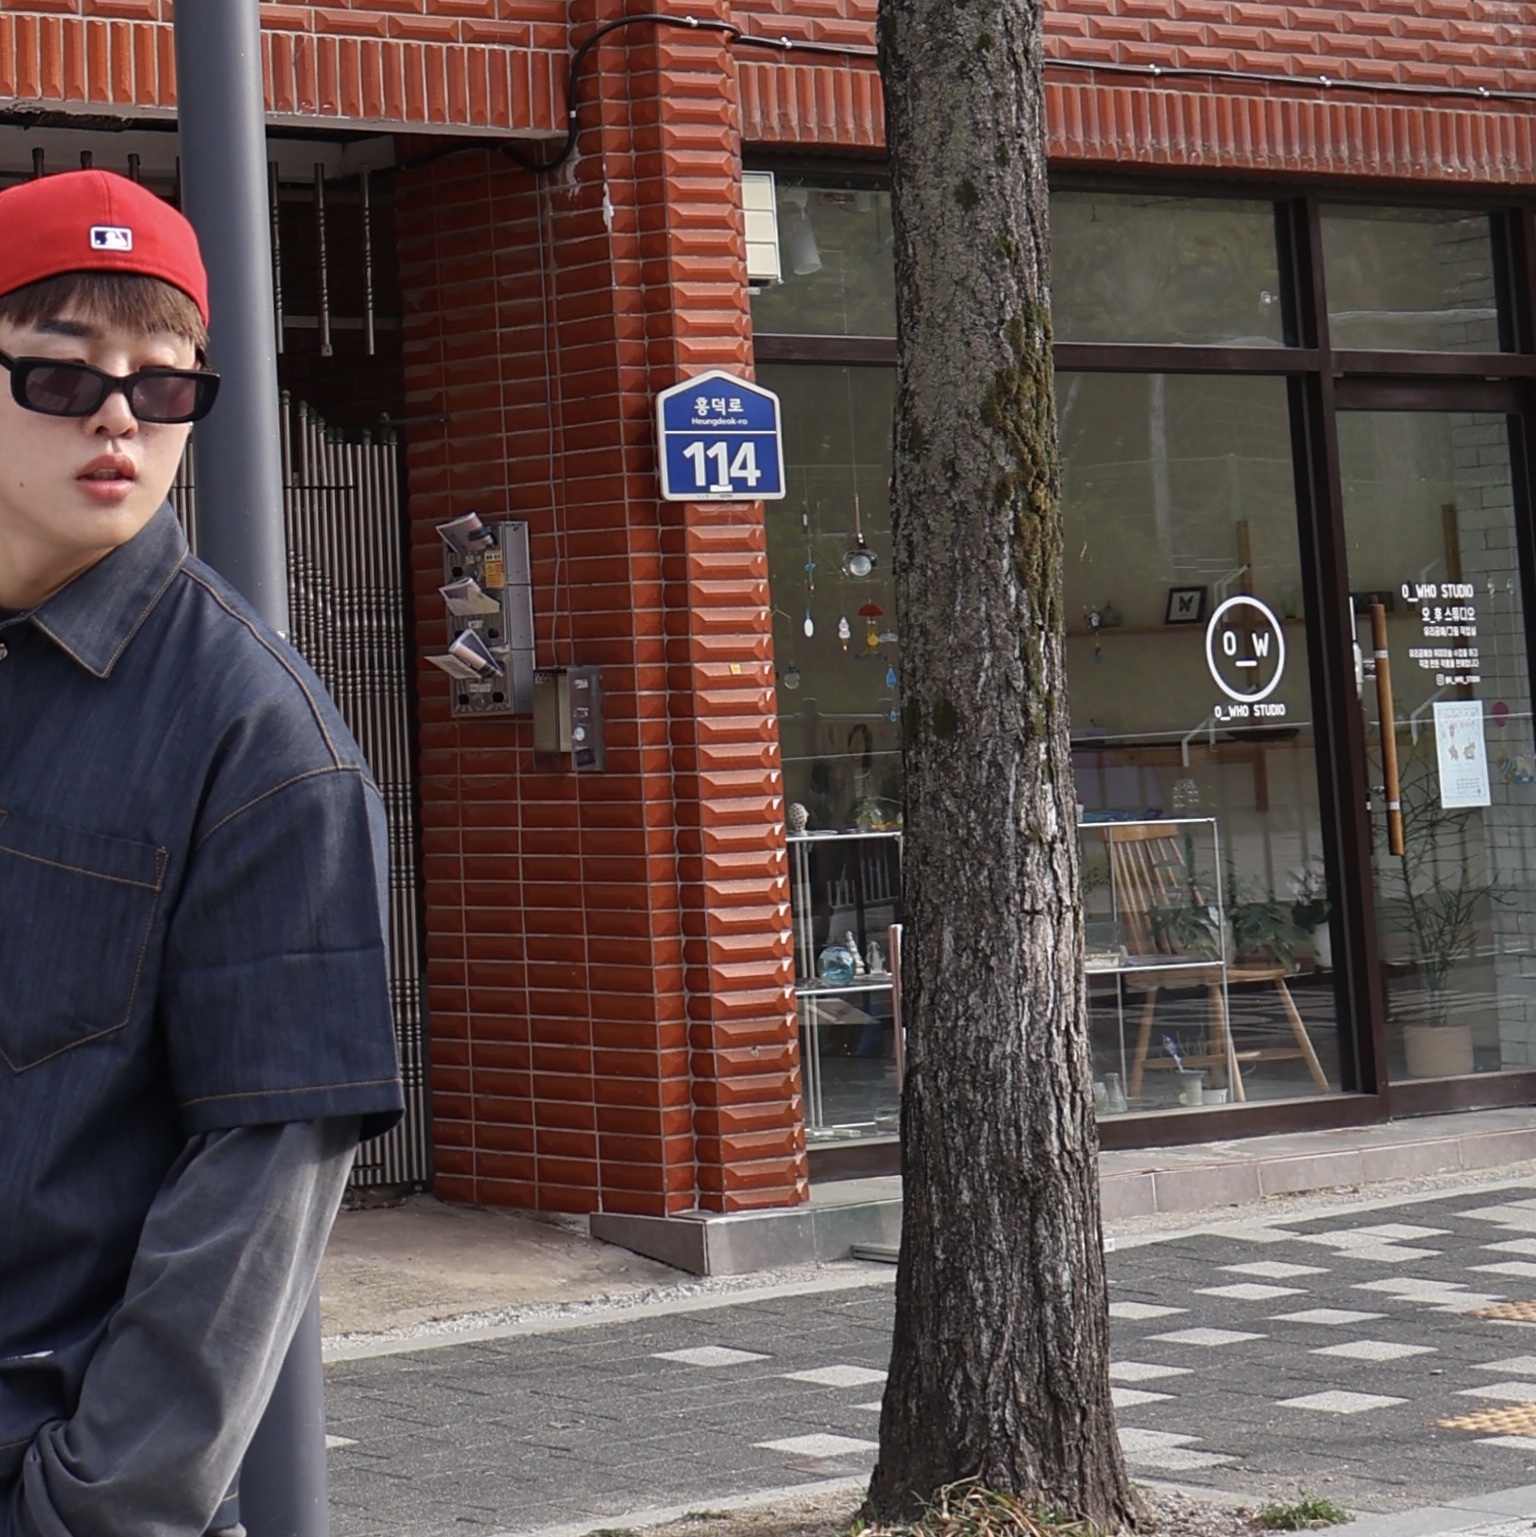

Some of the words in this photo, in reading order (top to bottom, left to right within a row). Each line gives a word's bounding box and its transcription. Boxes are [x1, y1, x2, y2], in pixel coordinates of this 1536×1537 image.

[694, 397, 744, 416] 흥덕로
[691, 417, 748, 427] Heungdeok-ro
[682, 441, 762, 487] 114
[1401, 583, 1438, 603] O_WHO
[1440, 583, 1474, 598] STUDIO
[1421, 606, 1442, 623] 오_후
[1444, 606, 1476, 621] 스튜디오
[1214, 704, 1249, 721] O_WHO
[1253, 703, 1286, 717] STUDIO
